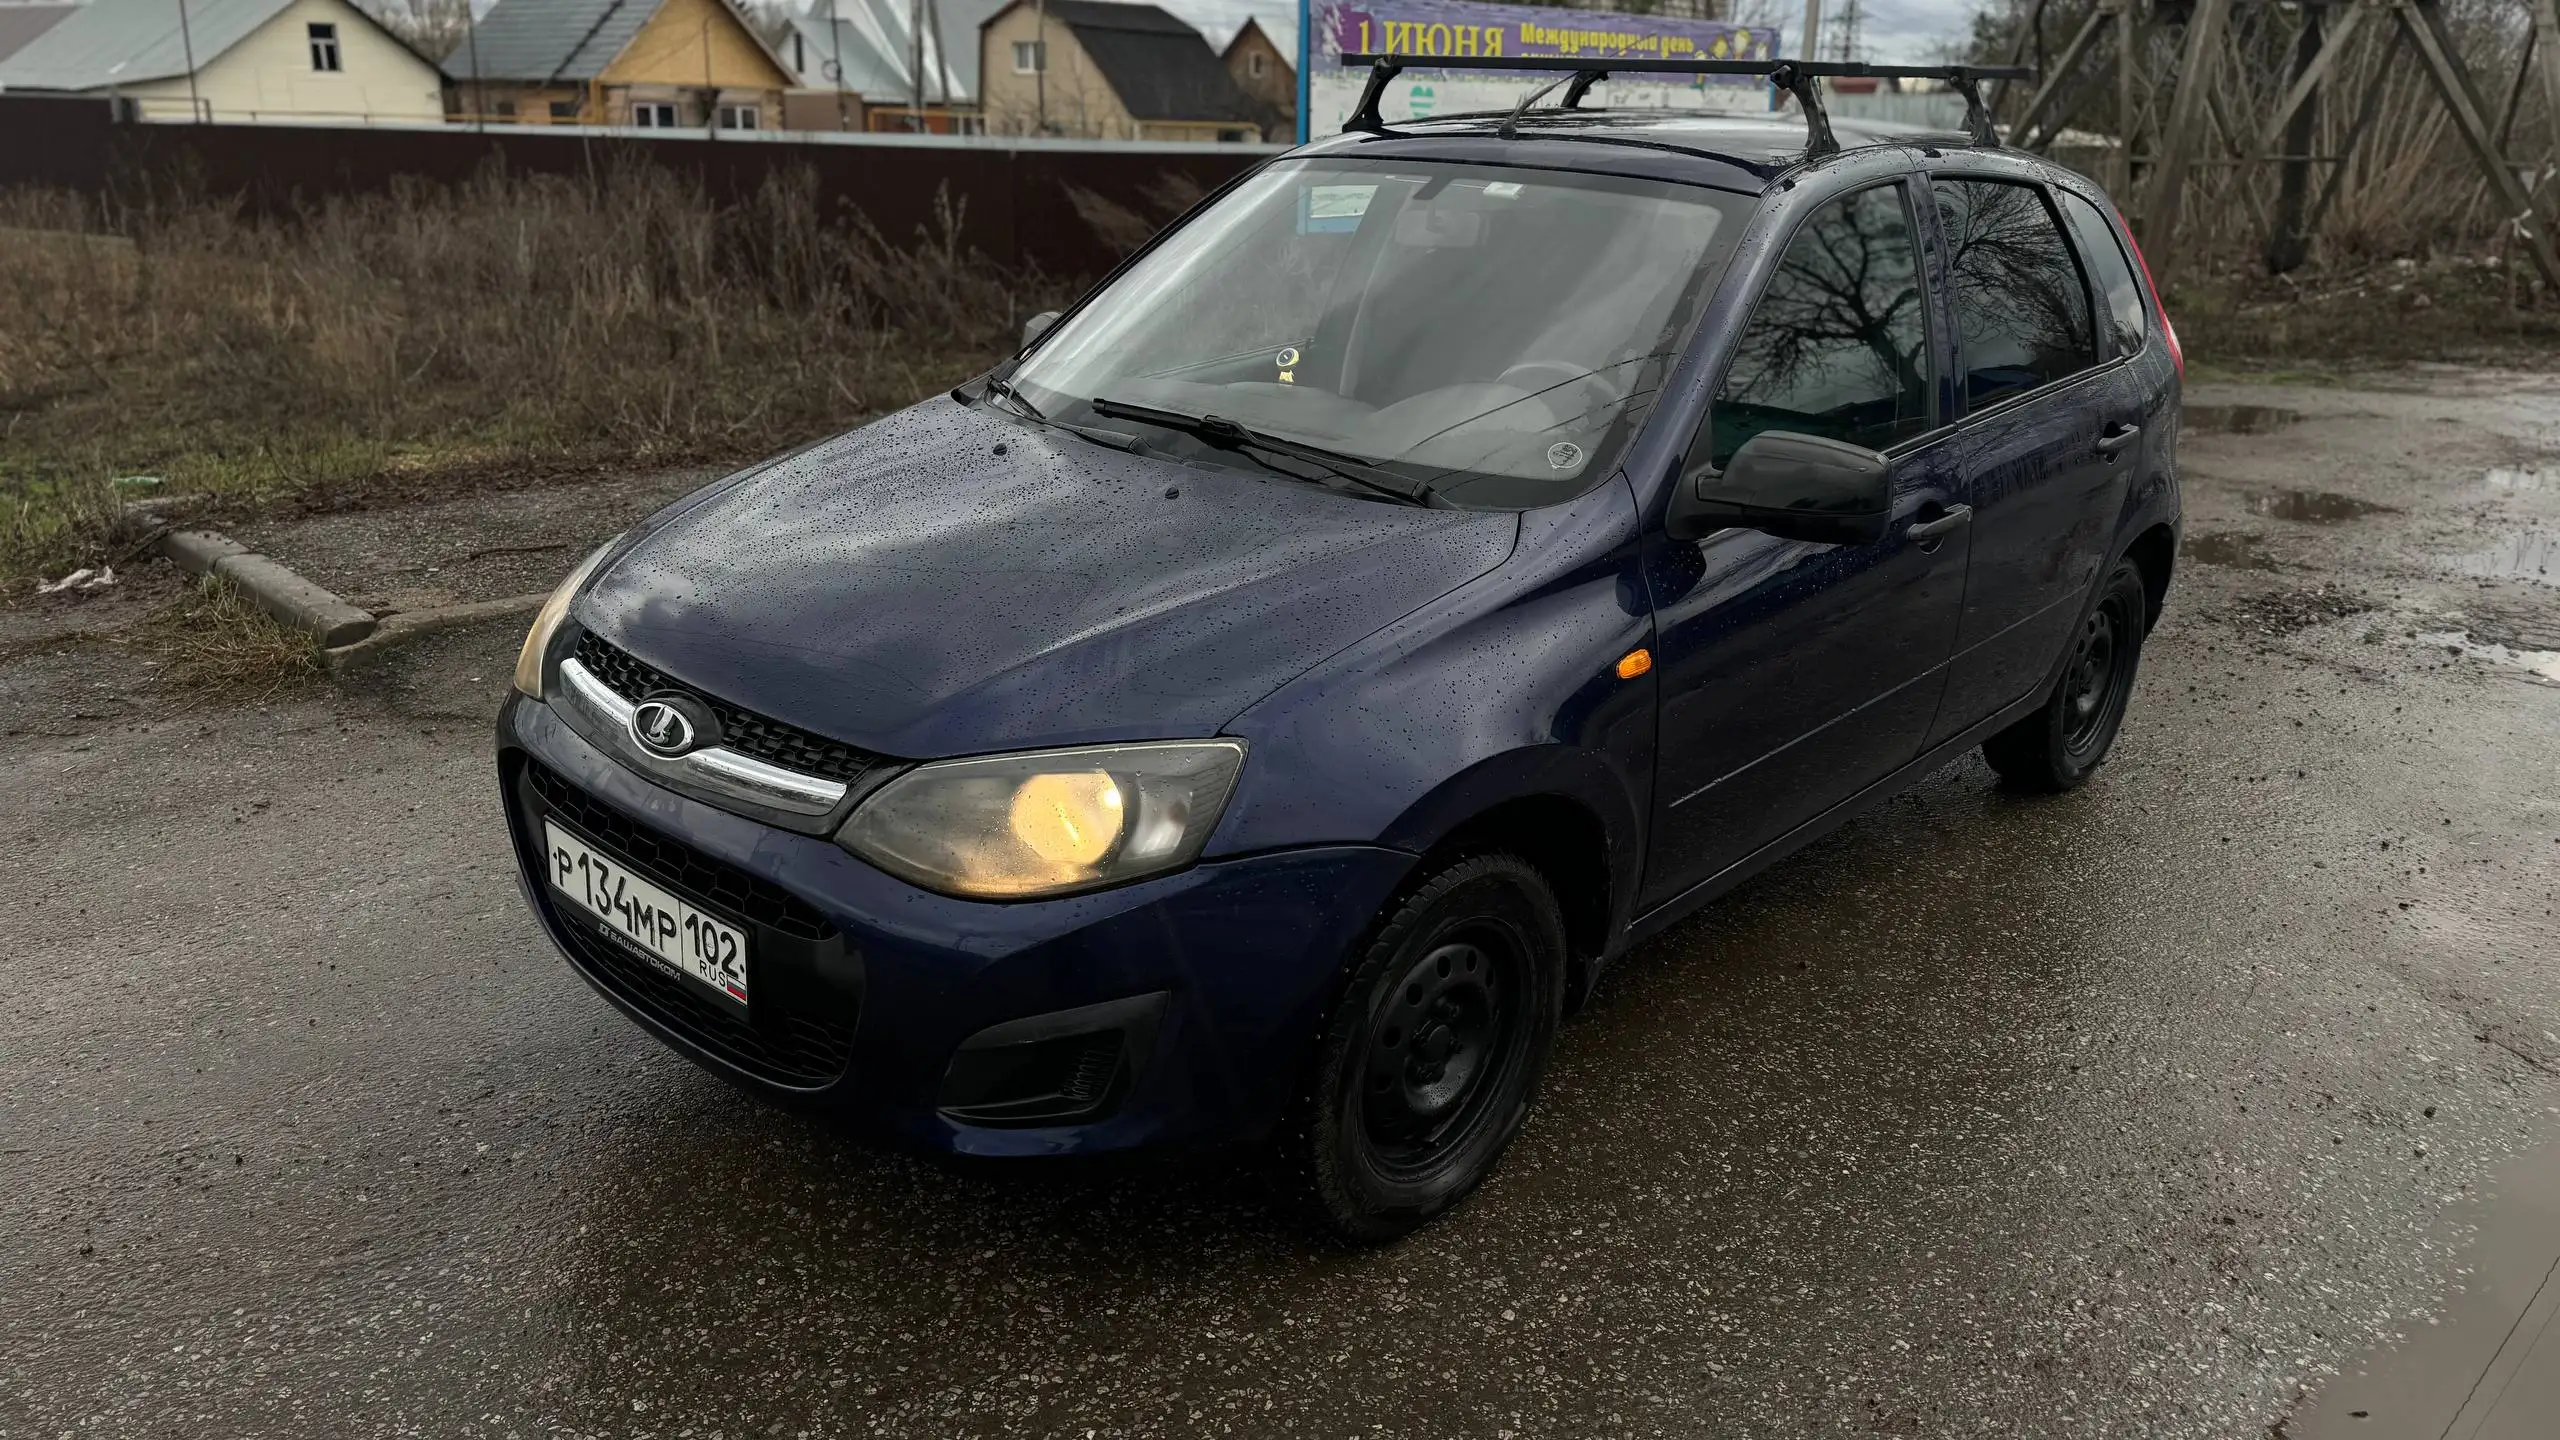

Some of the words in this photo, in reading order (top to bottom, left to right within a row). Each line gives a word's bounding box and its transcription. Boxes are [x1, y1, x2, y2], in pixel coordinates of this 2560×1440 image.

[1358, 20, 1371, 56] 1
[1383, 20, 1505, 57] ИЮНЯ
[1661, 36, 1695, 58] день
[684, 913, 739, 978] 102
[699, 960, 726, 987] RUS
